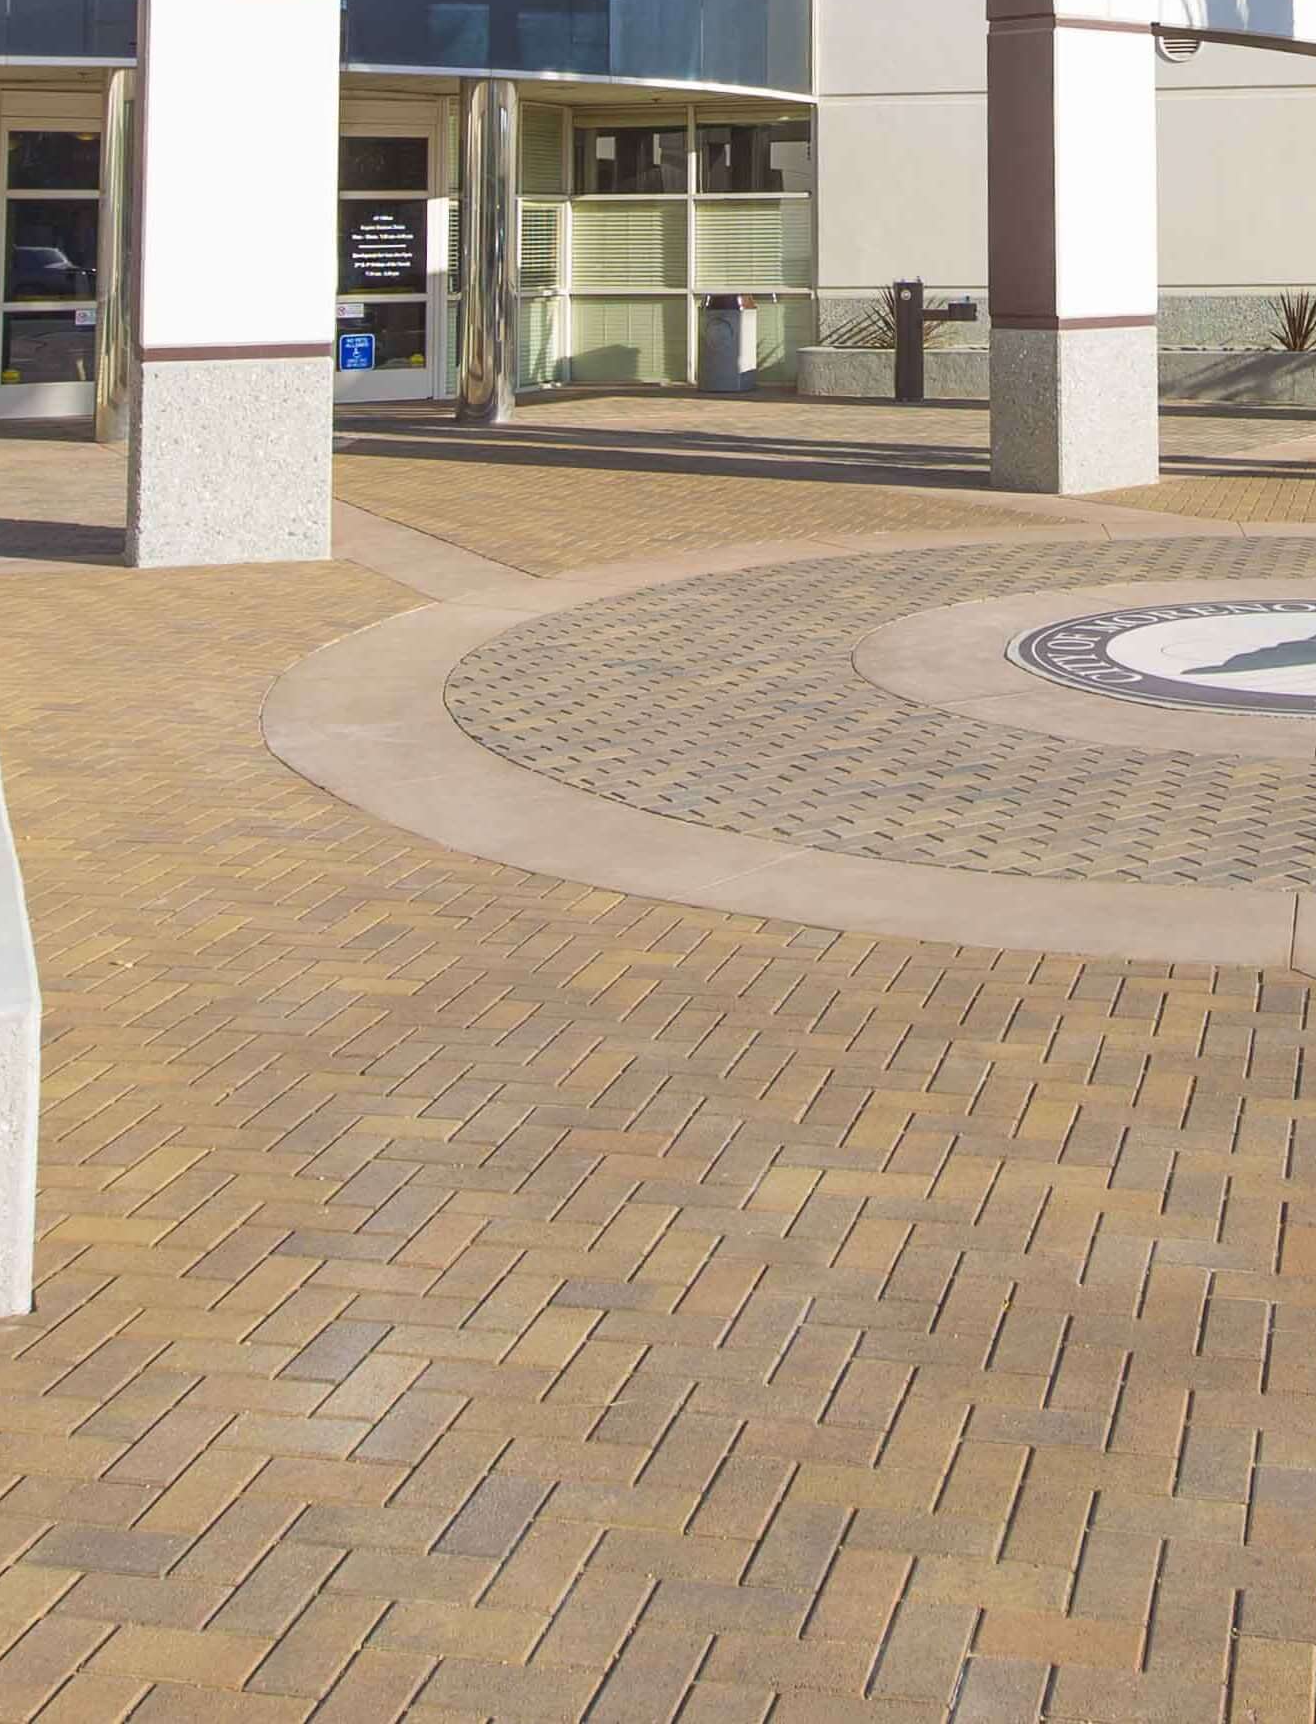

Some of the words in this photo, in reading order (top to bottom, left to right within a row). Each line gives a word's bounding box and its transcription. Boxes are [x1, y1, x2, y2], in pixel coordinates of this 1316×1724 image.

[1074, 603, 1316, 633] MORENO
[1047, 632, 1102, 650] OF
[1047, 653, 1143, 683] CITY
